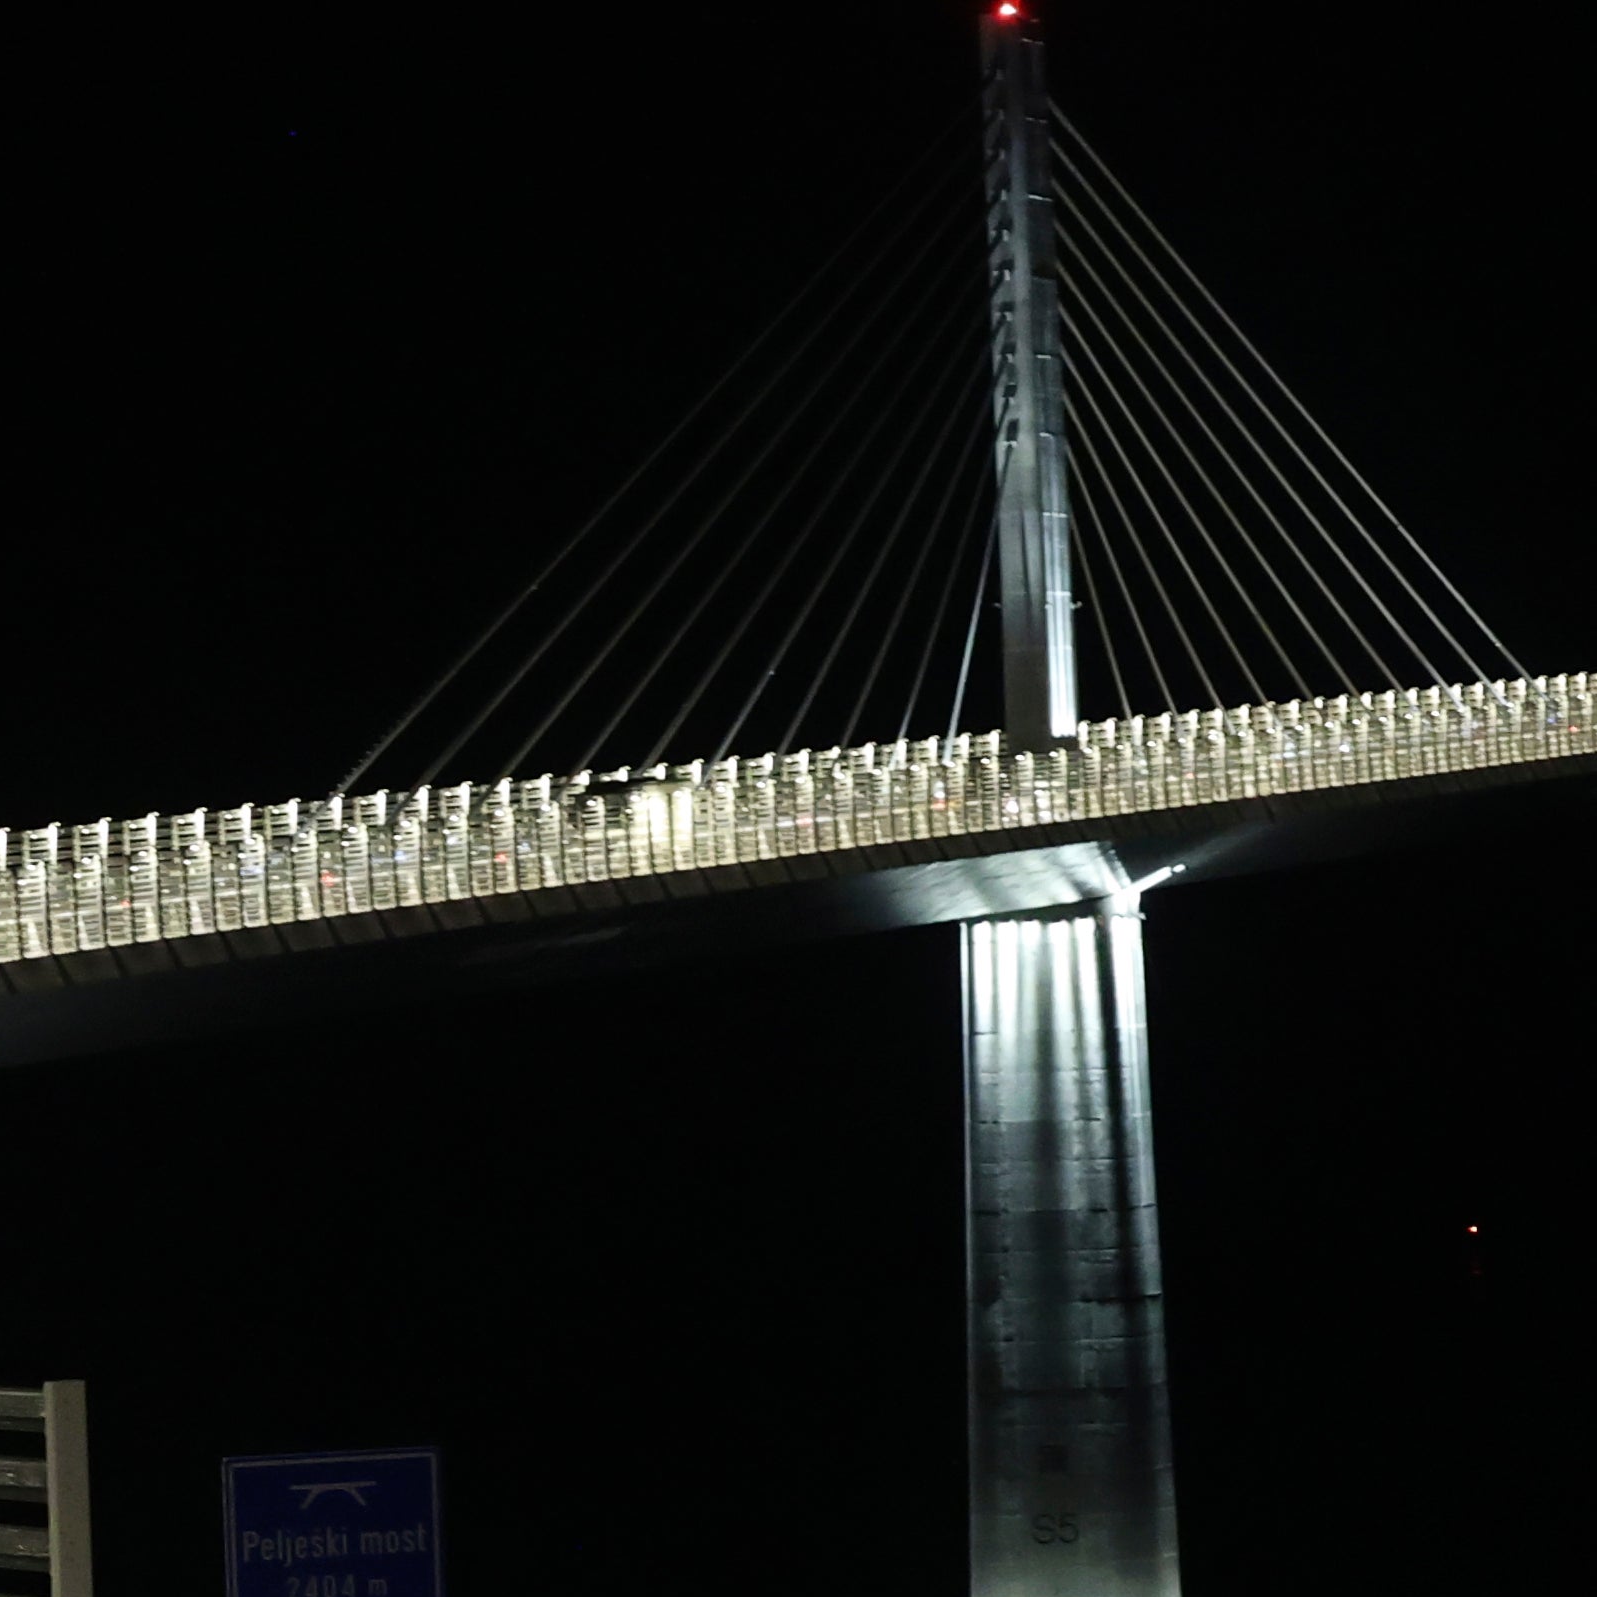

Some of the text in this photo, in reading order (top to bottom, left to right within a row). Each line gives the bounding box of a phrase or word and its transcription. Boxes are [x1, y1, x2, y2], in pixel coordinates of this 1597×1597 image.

[243, 1523, 428, 1567] Pelješki most
[1033, 1513, 1079, 1545] S5
[367, 1577, 388, 1597] m
